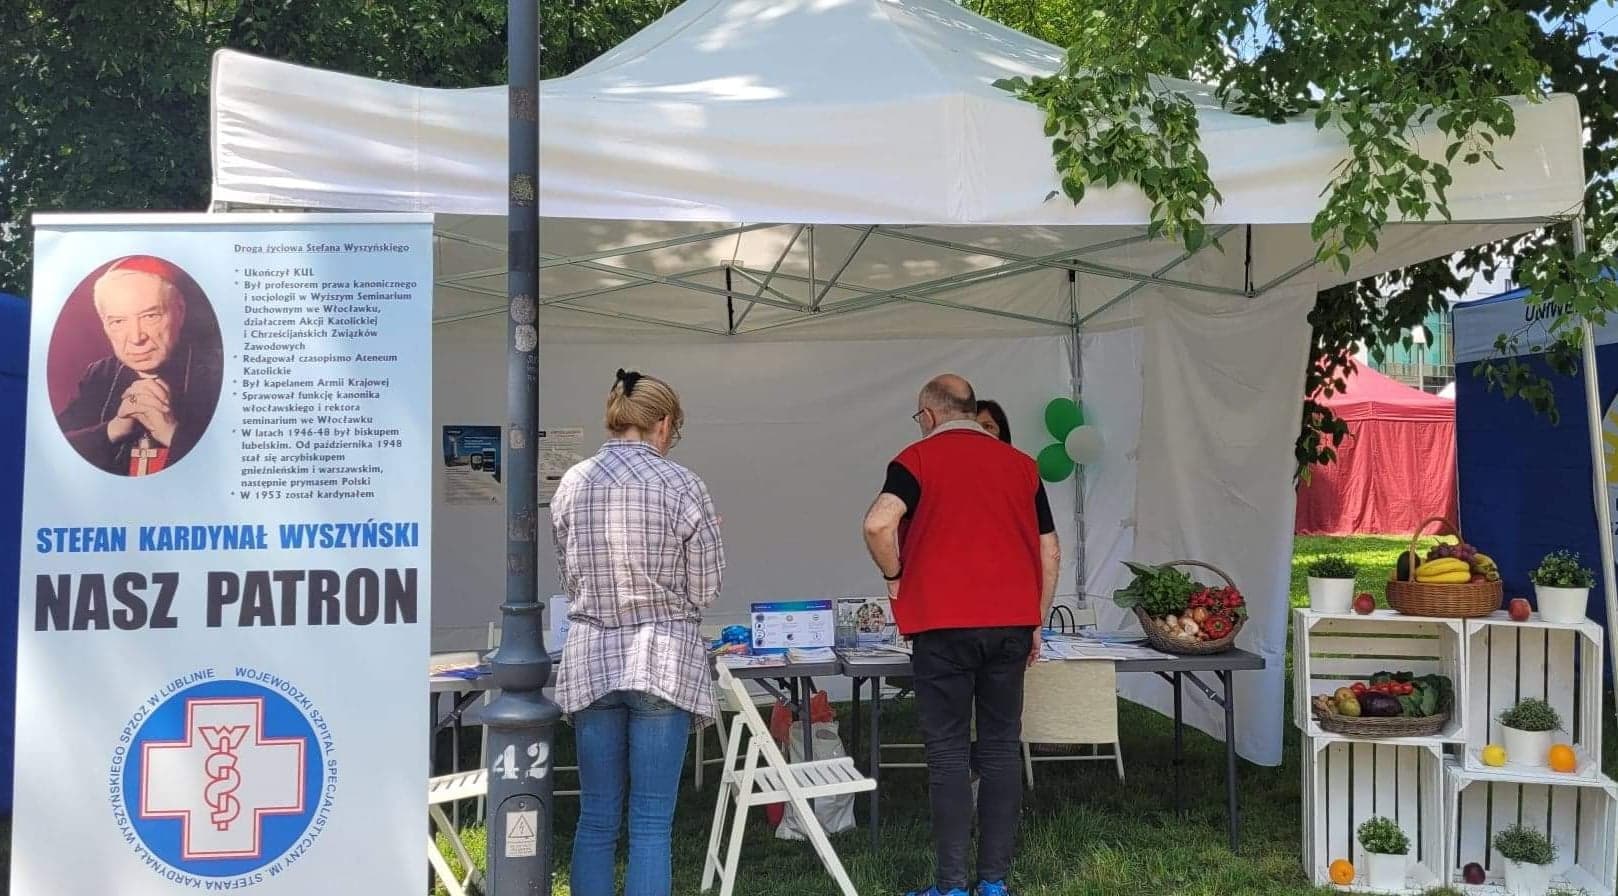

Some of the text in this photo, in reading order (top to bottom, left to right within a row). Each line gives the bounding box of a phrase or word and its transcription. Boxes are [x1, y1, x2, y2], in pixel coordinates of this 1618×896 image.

[234, 243, 409, 253] Droga życiowa Stefana Wyszyńskiego
[245, 269, 289, 278] Ukończył
[245, 281, 416, 290] Był profesorem prawa kanonicznego
[245, 293, 247, 301] i
[252, 293, 296, 302] socjologii
[311, 293, 353, 301] Wyższym
[358, 292, 411, 300] Seminarium
[245, 306, 302, 315] Duchownym
[323, 305, 381, 314] Włocławku,
[244, 317, 377, 326] działaczem Akcji Katolickiej
[251, 330, 327, 339] Chrześcijańskich
[332, 330, 377, 339] Związków
[244, 343, 305, 352] Zawodowych
[243, 354, 397, 364] Redagował czasopismo Ateneum
[244, 367, 291, 375] Katolickie
[243, 380, 260, 388] Był
[264, 379, 313, 388] kapelanem
[348, 379, 389, 388] Krajowej
[243, 391, 380, 401] Sprawował funkcję kanonika
[243, 404, 314, 413] włocławskiego
[317, 416, 373, 424] Włocławku
[242, 428, 399, 437] W latach 1946-48 był biskupem
[296, 441, 310, 449] Od
[314, 440, 372, 449] października
[378, 440, 402, 448] 1948
[264, 453, 277, 462] się
[281, 453, 345, 462] arcybiskupem
[241, 465, 383, 476] gnieźnieńskim i warszawskim,
[241, 478, 370, 488] następnie prymasem Polski
[256, 491, 281, 499] 1953
[286, 491, 313, 499] został
[317, 490, 374, 499] kardynałem
[36, 519, 419, 553] STEFAN KARDYNAŁ WYSZYŃSKI
[34, 568, 418, 631] NASZ PATRON
[160, 668, 215, 698] LUBLINIE
[235, 667, 313, 711] WOJEWÓDZKI
[148, 695, 160, 708] W
[120, 706, 151, 744] SPZOZ
[310, 710, 335, 756] SZPITAL
[493, 742, 549, 779] 42
[110, 746, 136, 844] WYSZYŃSKIEGO
[286, 760, 338, 866] SPECJALISTYCZNY
[134, 843, 200, 889] KARDYNAŁA
[206, 872, 263, 890] STEFANA
